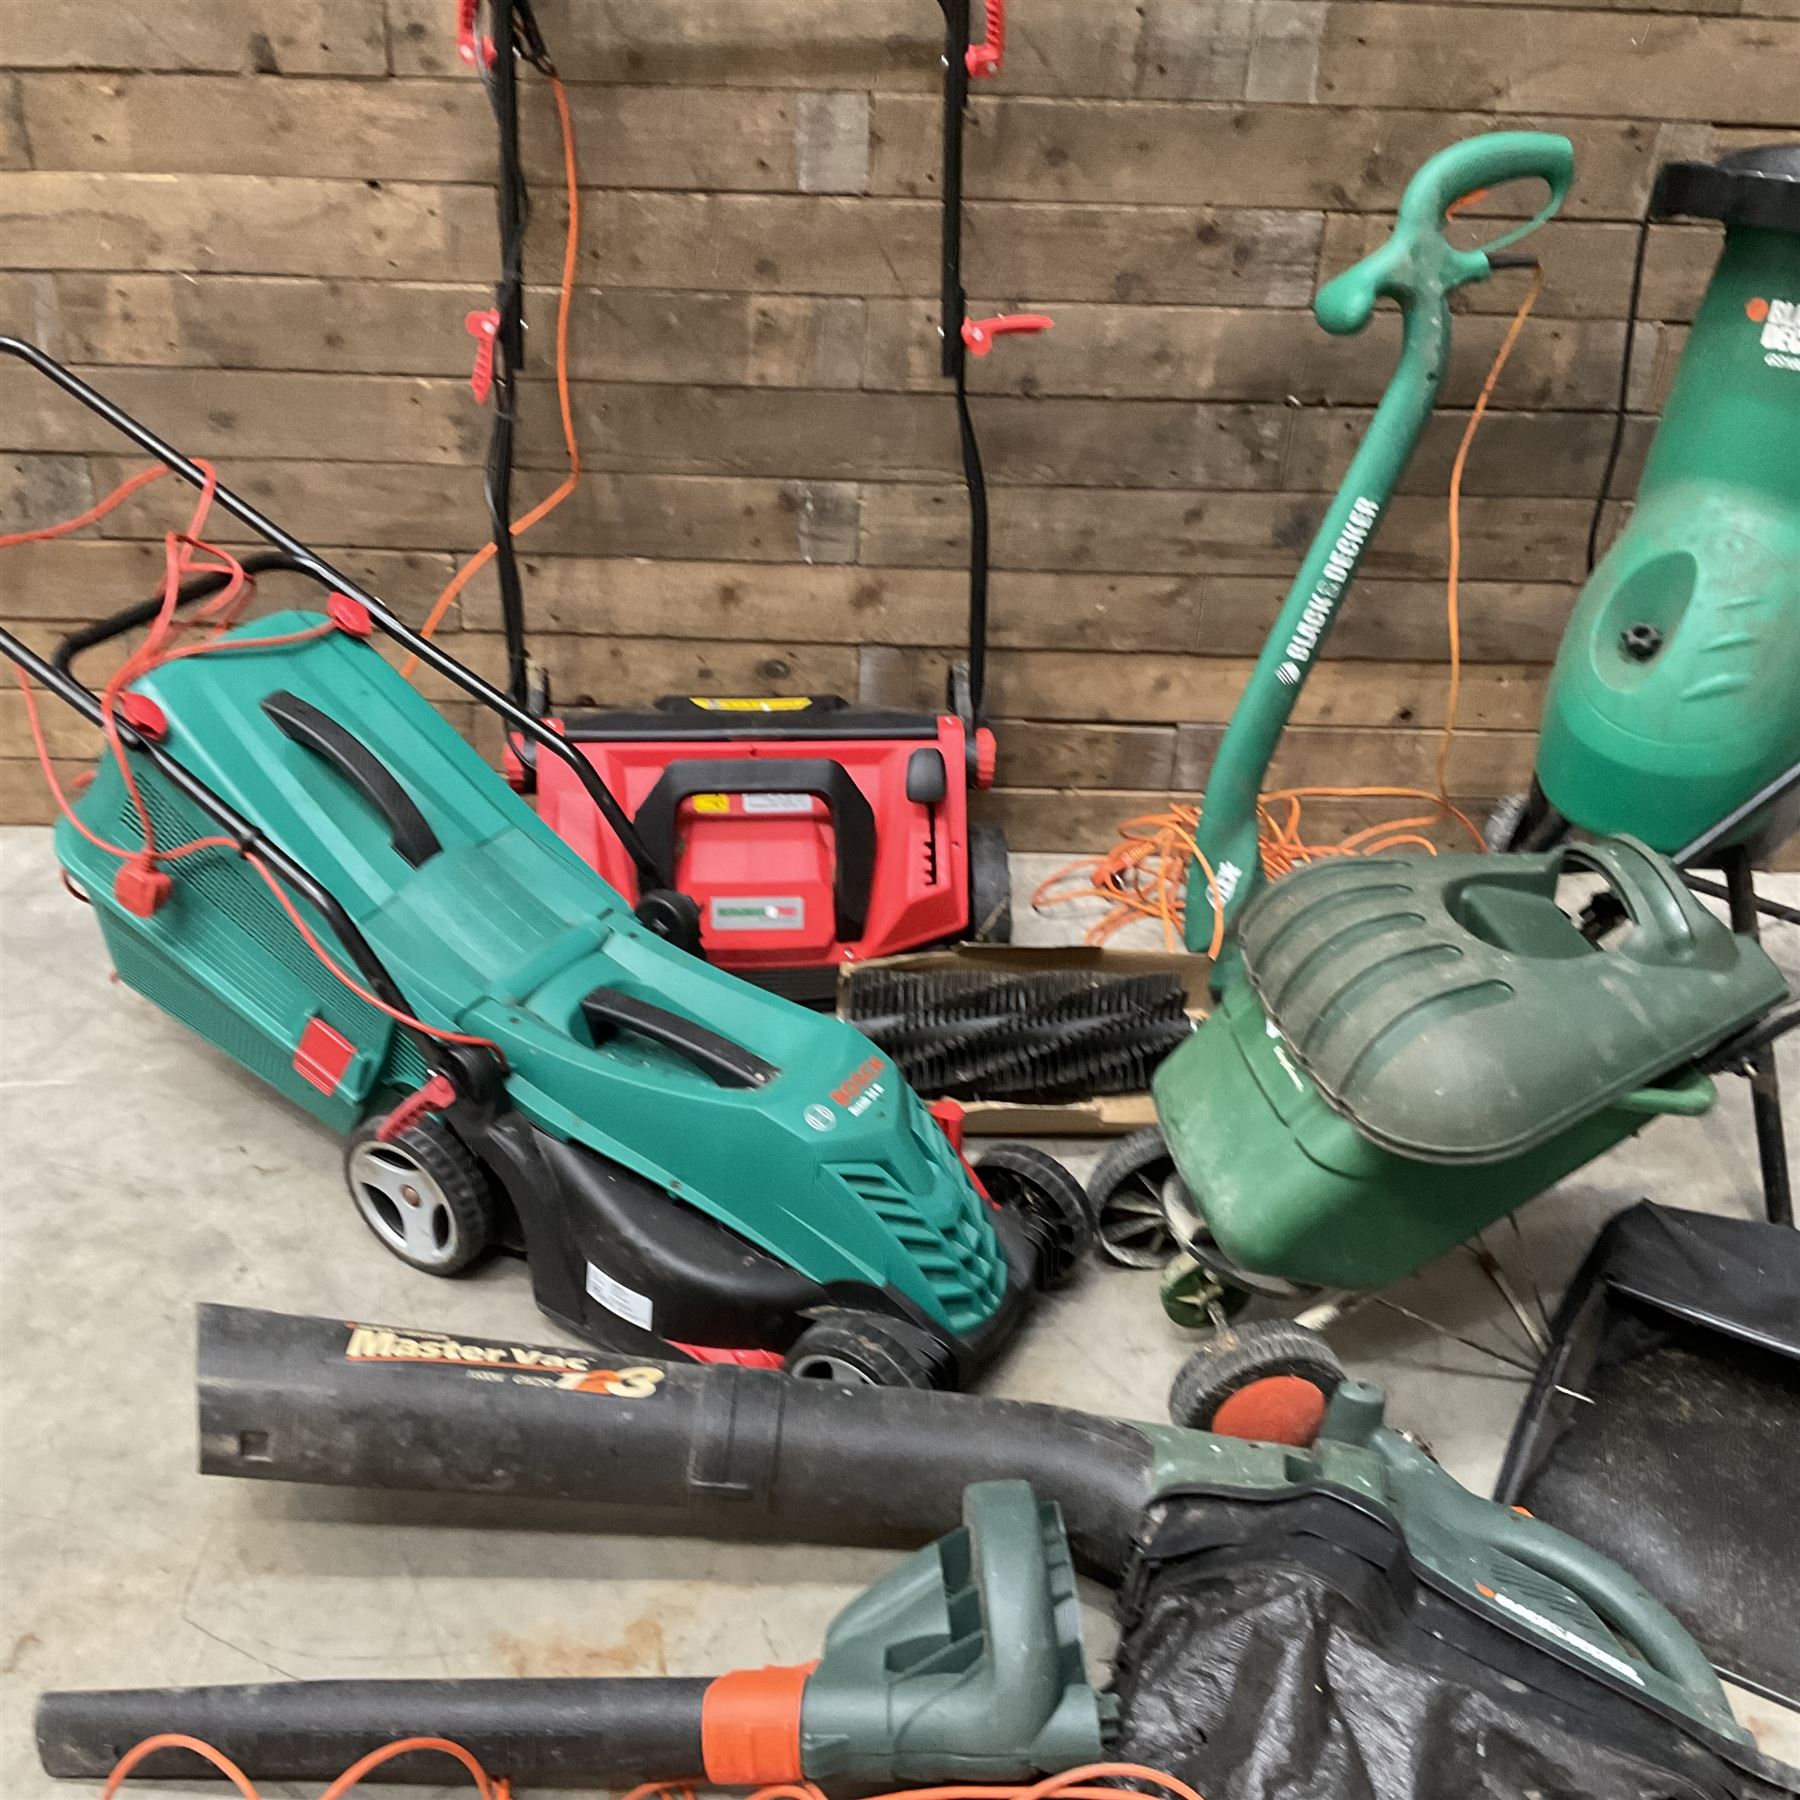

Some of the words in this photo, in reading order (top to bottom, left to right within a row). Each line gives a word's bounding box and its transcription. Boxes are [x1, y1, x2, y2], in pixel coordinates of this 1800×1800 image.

[830, 1056, 886, 1108] BOSCH
[346, 1327, 507, 1362] Master
[510, 1347, 590, 1371] Vac
